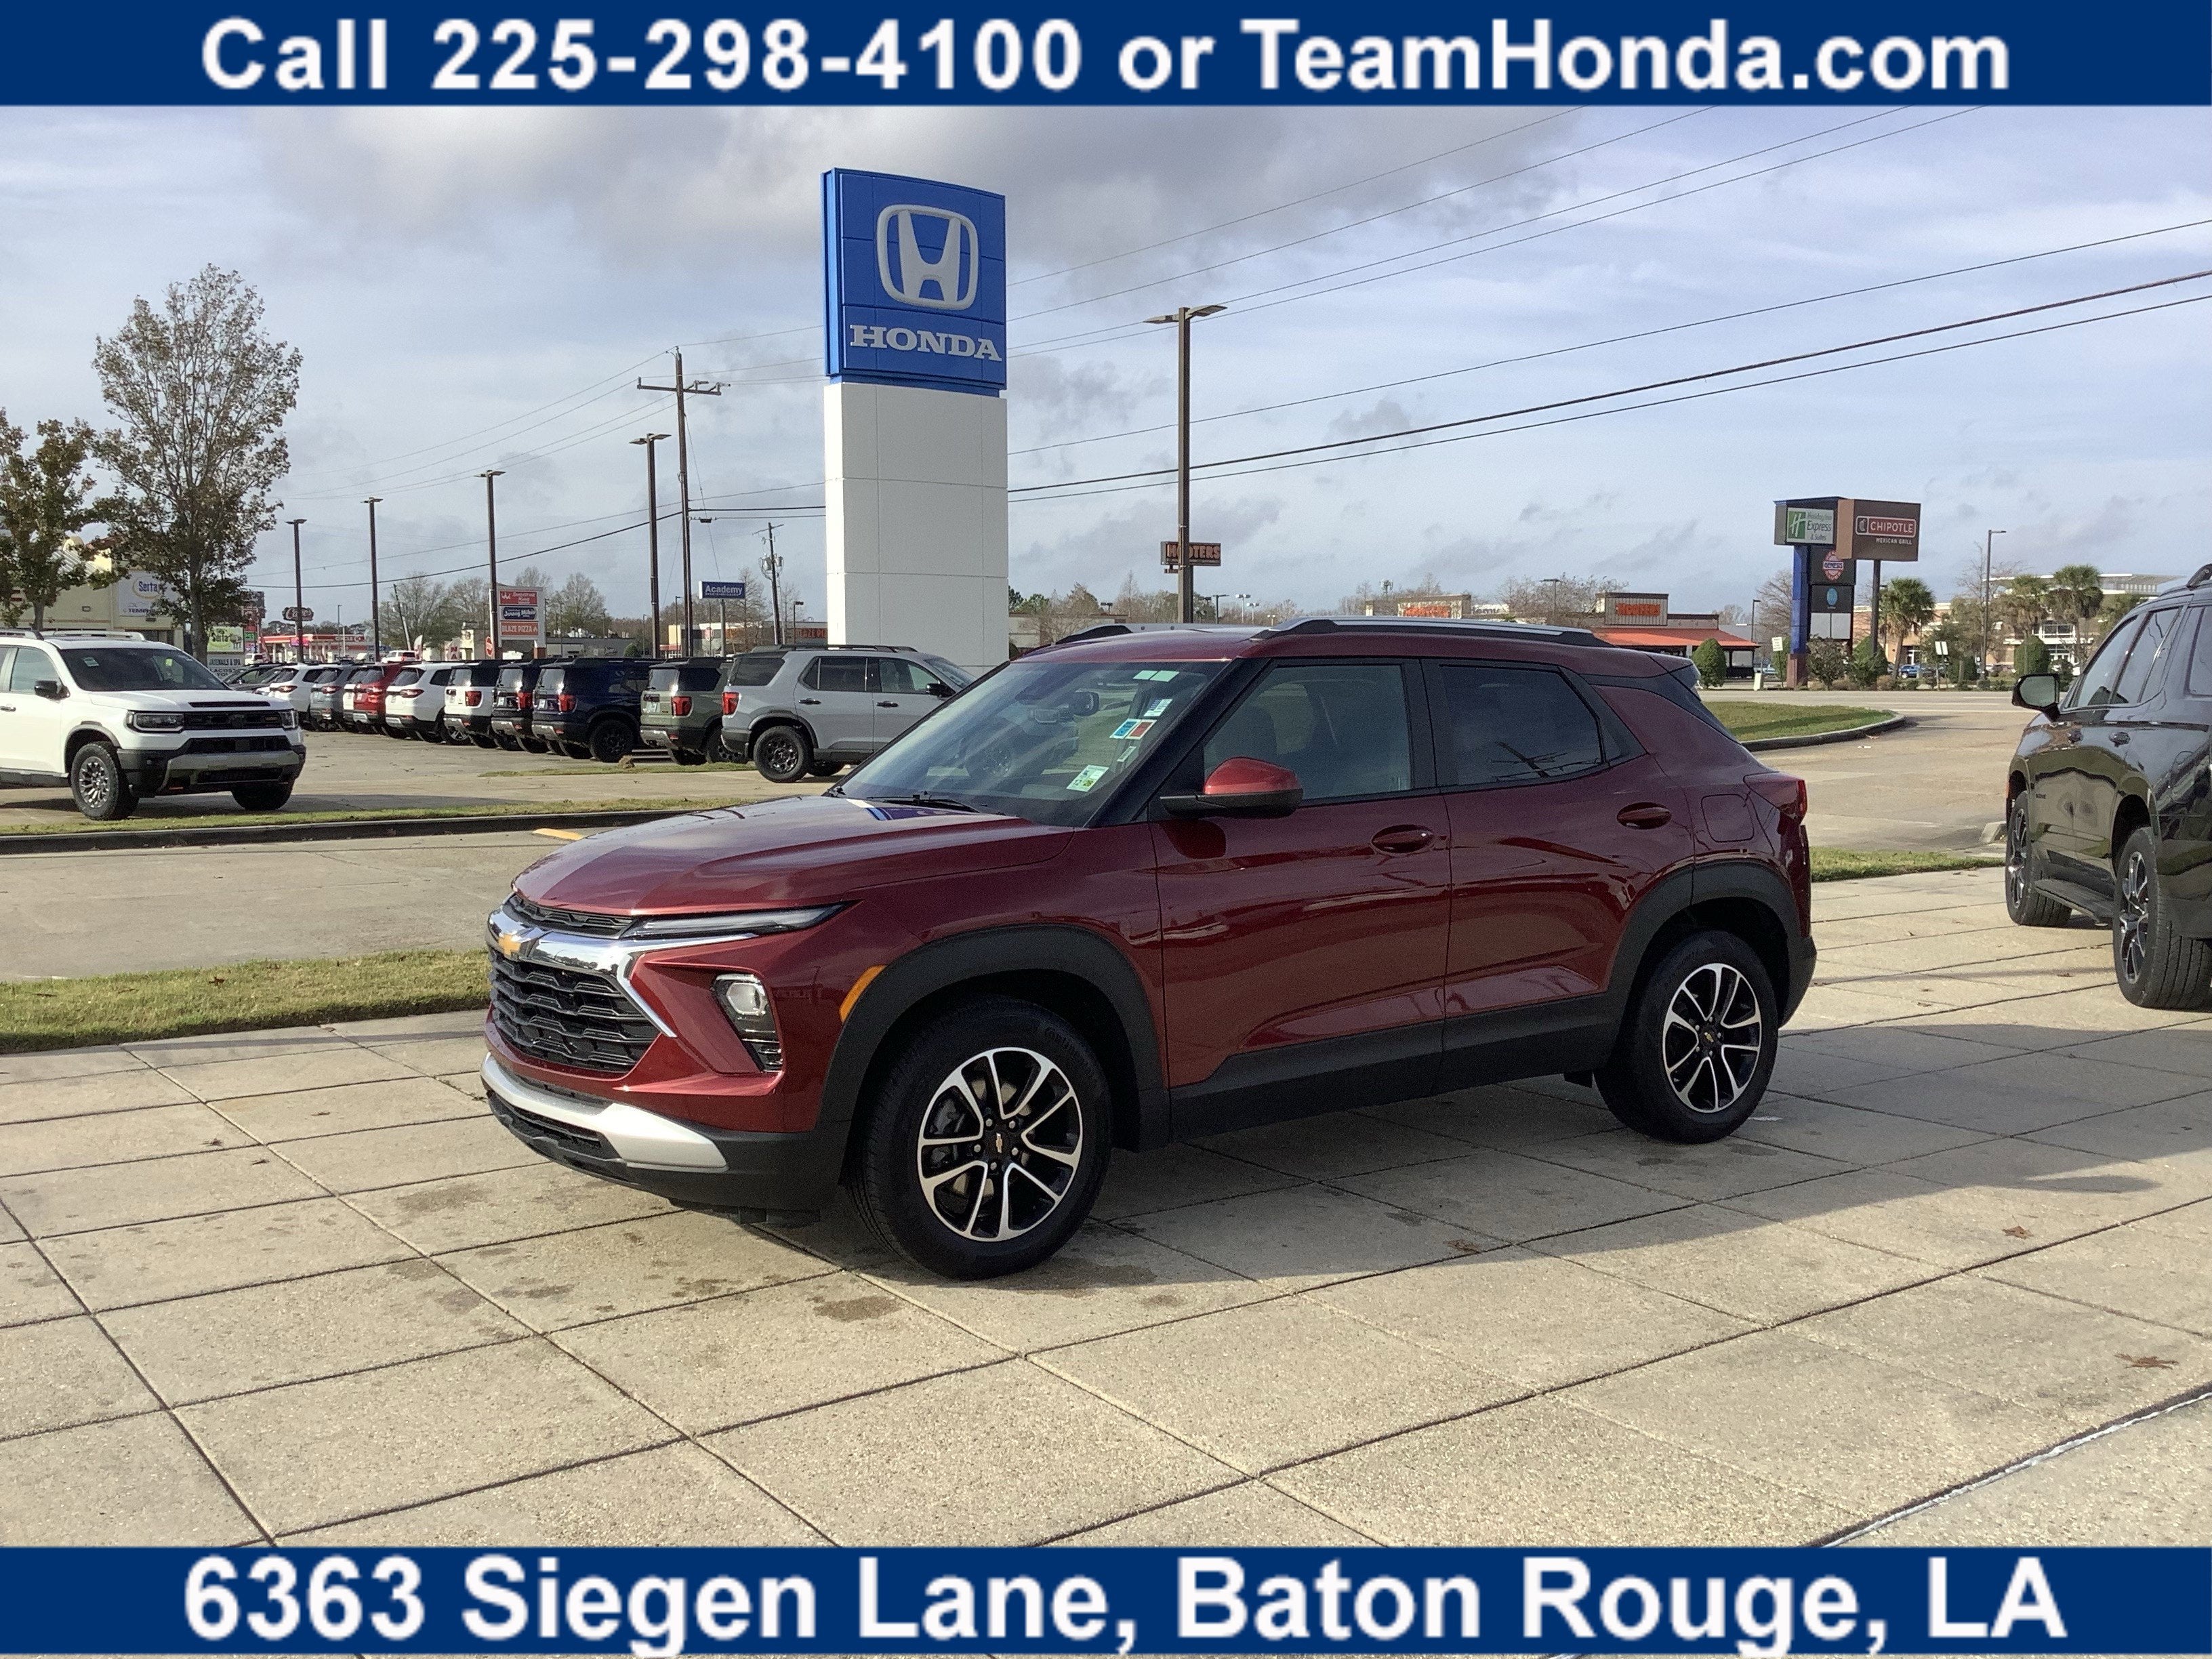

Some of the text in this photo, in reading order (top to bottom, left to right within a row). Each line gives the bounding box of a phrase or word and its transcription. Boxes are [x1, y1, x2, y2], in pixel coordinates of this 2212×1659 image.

[850, 324, 1002, 361] HONDA
[1807, 520, 1832, 533] Express
[1870, 521, 1914, 533] CHIPOTLE
[138, 581, 158, 592] Serta
[705, 585, 743, 596] Academy
